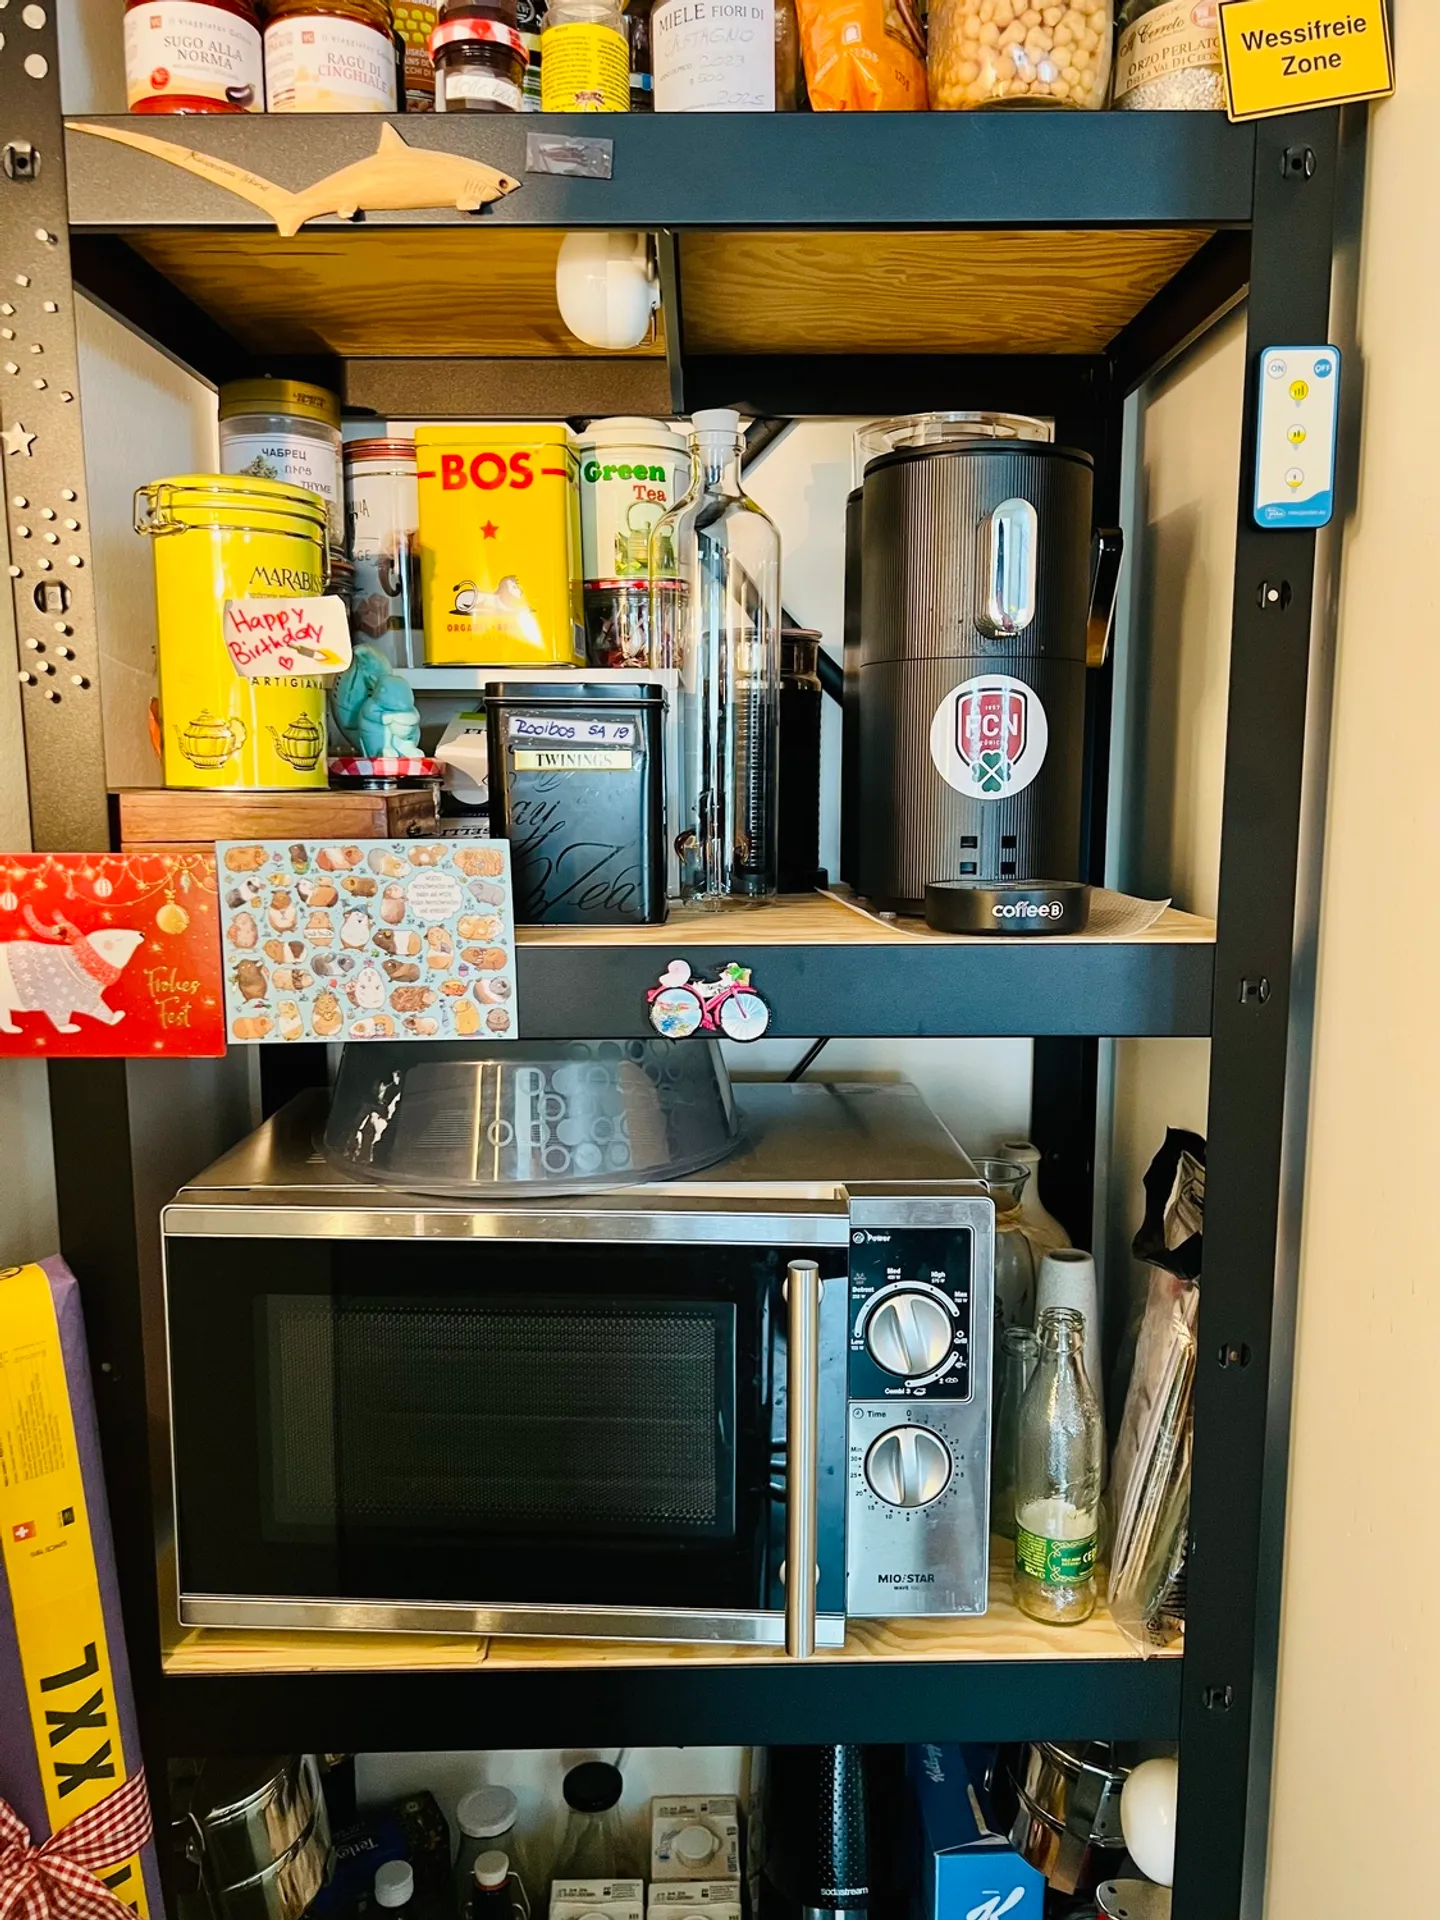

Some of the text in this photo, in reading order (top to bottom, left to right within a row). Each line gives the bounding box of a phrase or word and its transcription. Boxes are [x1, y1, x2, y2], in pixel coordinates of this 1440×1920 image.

[660, 3, 764, 36] MIELE FIORI DI
[1240, 16, 1368, 52] Wessifreie
[163, 36, 243, 62] SUGO ALLA
[177, 49, 233, 70] NORMA
[327, 52, 366, 71] RAGÙ
[369, 62, 381, 78] DI
[1128, 52, 1160, 77] ORZO
[1281, 52, 1343, 77] Zone
[318, 65, 388, 95] CINGHIALE
[1314, 363, 1331, 373] OFF
[261, 447, 308, 461] ЧАБРЕЦ
[441, 451, 535, 491] BOS
[583, 460, 667, 483] Green
[300, 480, 333, 495] THYME
[632, 484, 667, 502] Tea
[228, 607, 304, 634] Happy
[228, 624, 325, 666] Birthday
[515, 719, 576, 739] Rooibos
[613, 726, 629, 739] 19
[535, 753, 614, 768] TWININGS
[155, 996, 192, 1030] Fest
[867, 1410, 887, 1418] Time
[39, 1641, 116, 1800] XXL
[820, 1886, 869, 1896] sodastream
